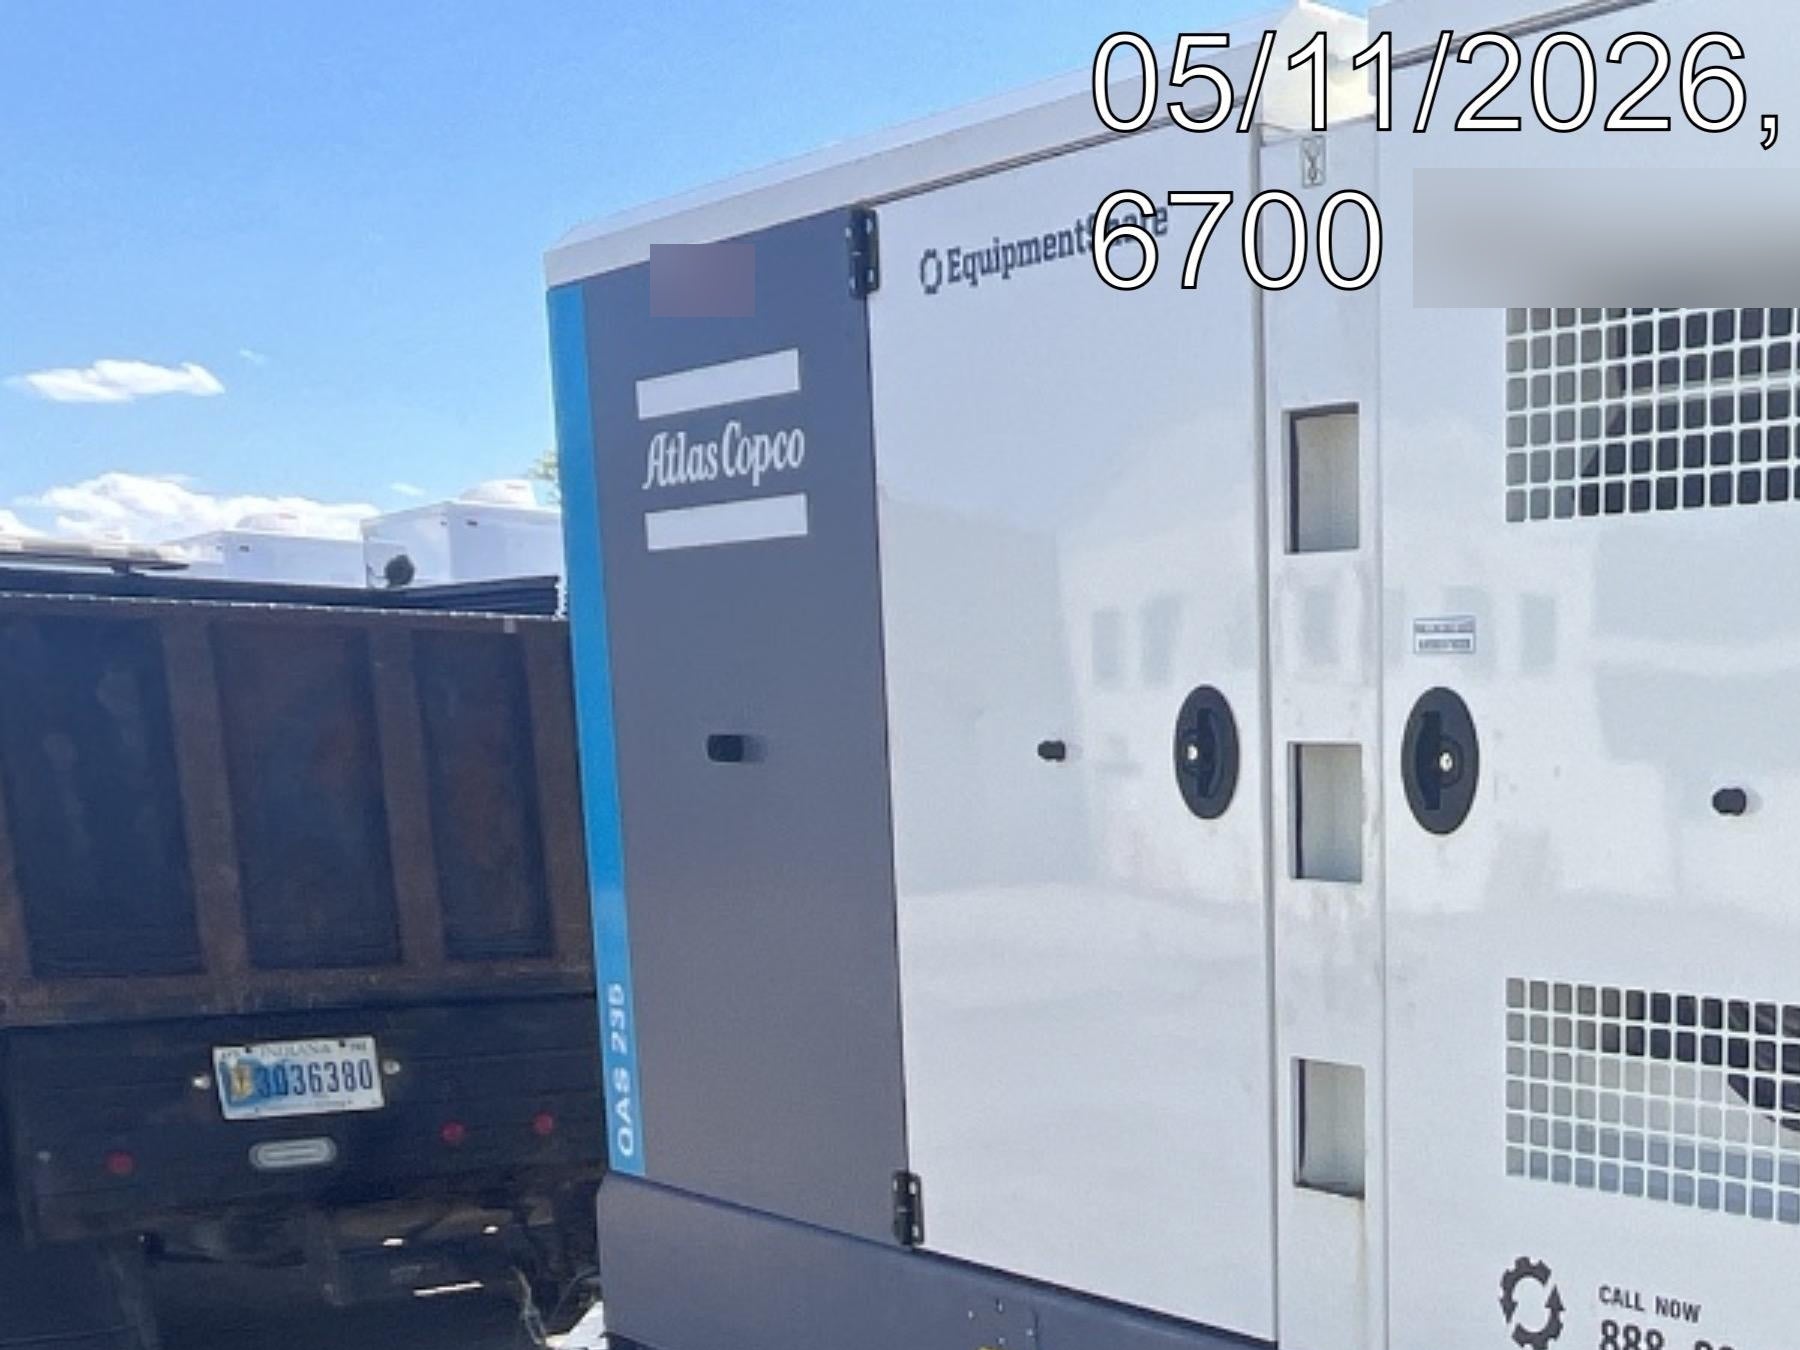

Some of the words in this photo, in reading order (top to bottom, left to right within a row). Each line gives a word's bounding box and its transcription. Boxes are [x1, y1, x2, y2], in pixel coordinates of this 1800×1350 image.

[641, 431, 718, 490] Atlas
[722, 420, 806, 488] Copco
[1598, 1285, 1645, 1313] CALL
[1655, 1295, 1702, 1324] NOW
